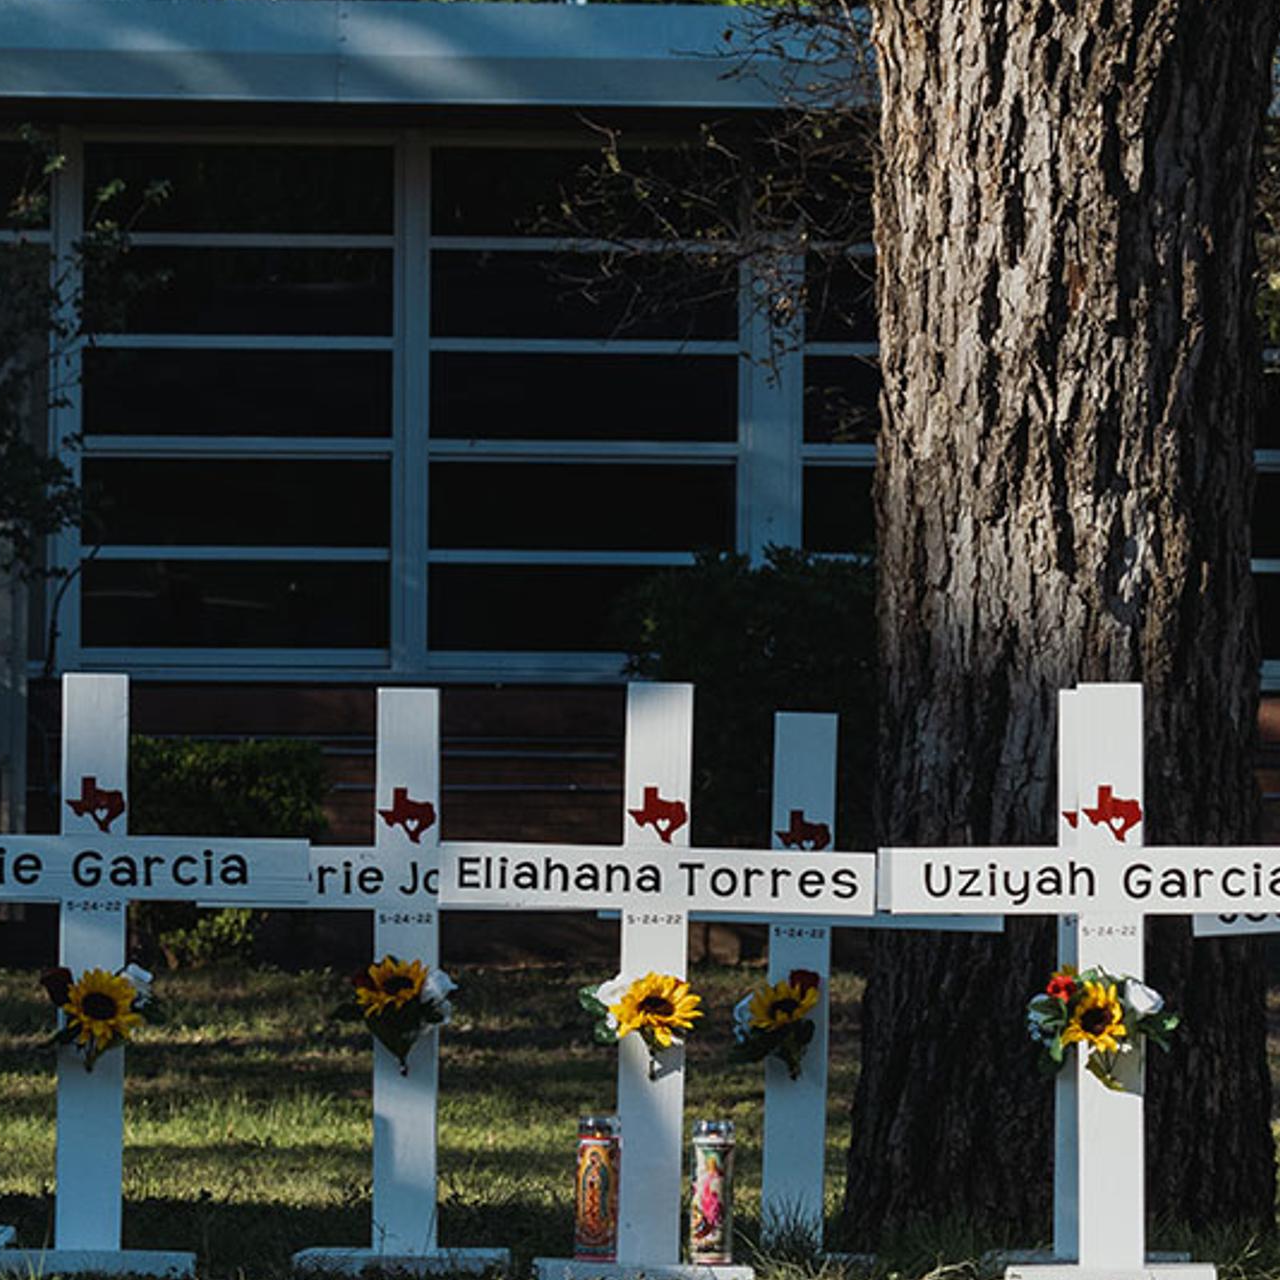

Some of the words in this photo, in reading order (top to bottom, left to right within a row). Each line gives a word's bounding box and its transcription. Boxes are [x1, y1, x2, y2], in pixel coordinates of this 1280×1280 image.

[72, 850, 247, 887] Garcia
[308, 860, 384, 895] rie
[458, 857, 661, 892] Eliahana
[680, 863, 858, 899] Torres
[924, 861, 1095, 905] Uziyah
[380, 913, 433, 924] 5-24-22
[628, 914, 681, 924] 5-24-22
[1081, 925, 1137, 936] 5-24-22
